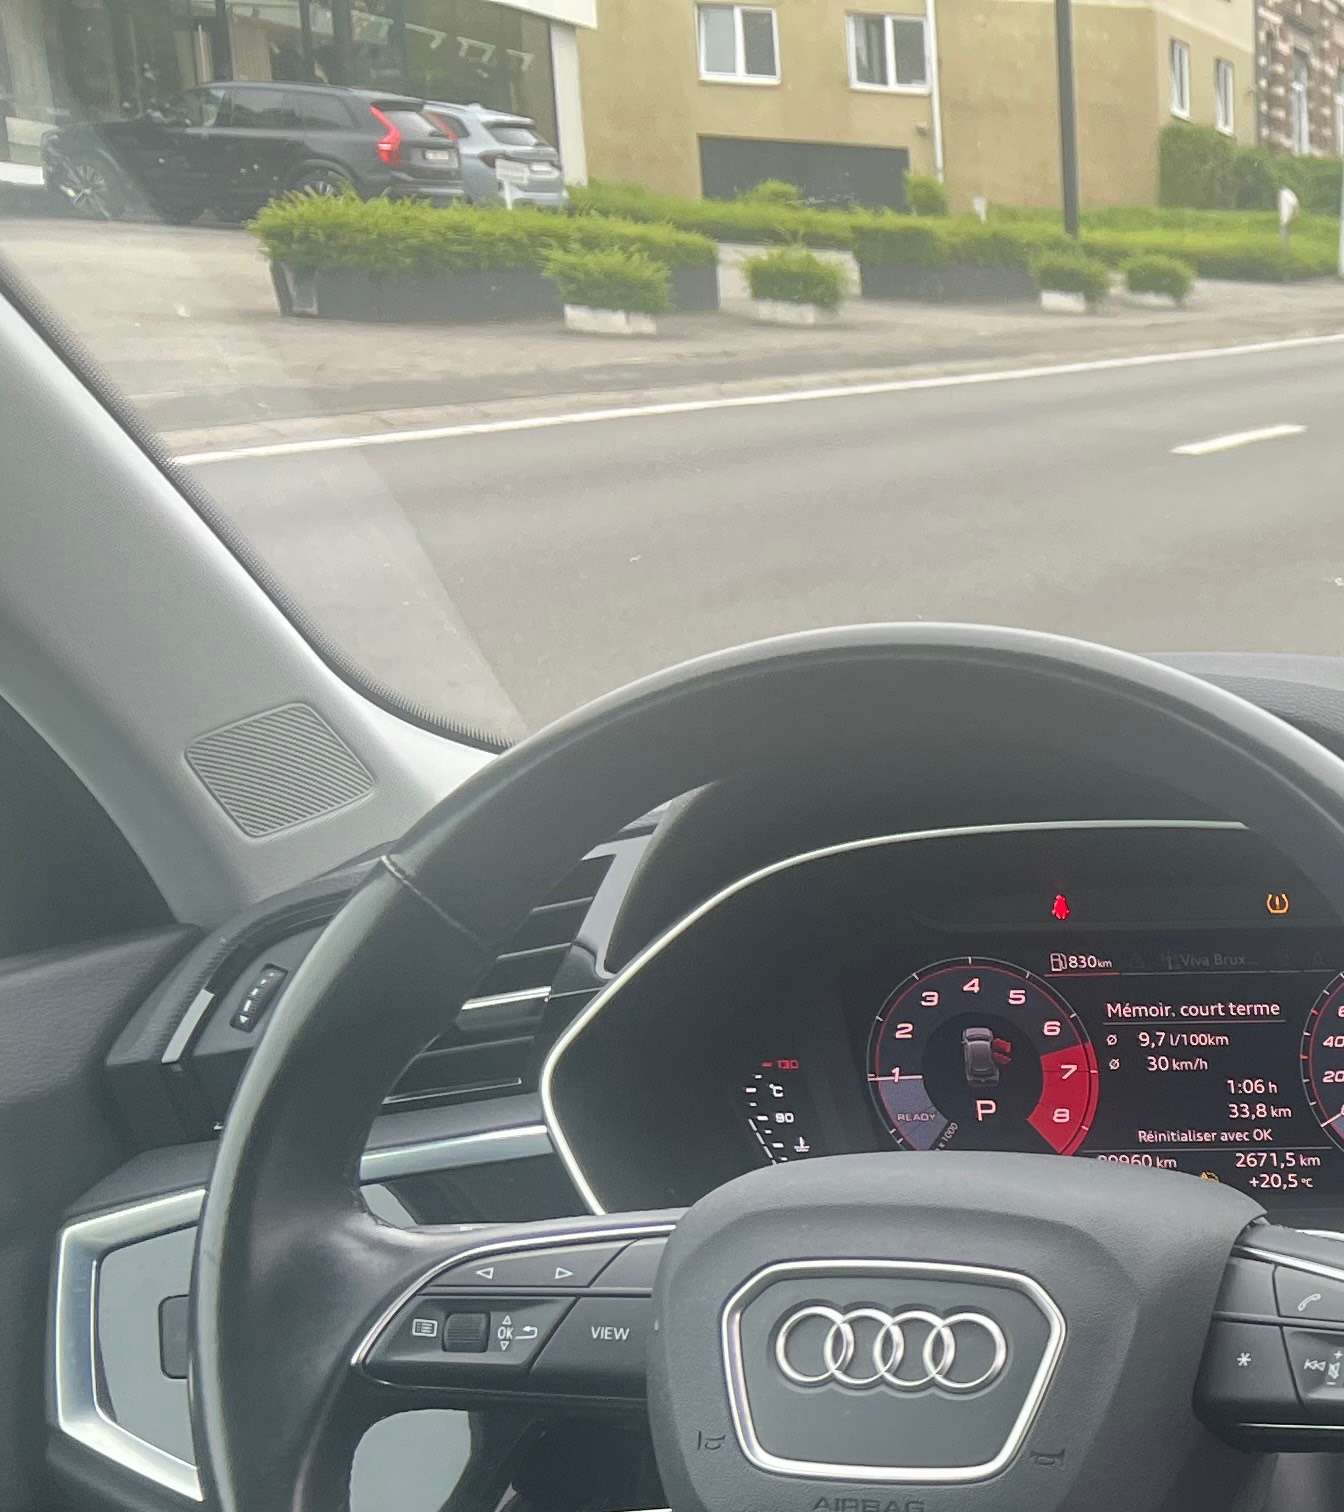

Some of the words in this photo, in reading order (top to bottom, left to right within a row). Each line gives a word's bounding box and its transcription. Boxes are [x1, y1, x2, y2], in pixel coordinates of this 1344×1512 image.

[963, 978, 981, 993] 4
[920, 992, 939, 1007] 3
[1008, 990, 1026, 1004] 5
[1107, 1002, 1176, 1018] Mémoir.
[1180, 1003, 1226, 1017] court
[1229, 1002, 1280, 1016] terme
[895, 1023, 914, 1039] 2
[1043, 1021, 1061, 1036] 6
[1139, 1031, 1166, 1049] 9,7
[1170, 1032, 1229, 1047] l/100km
[1147, 1056, 1169, 1071] 30
[1173, 1058, 1208, 1072] km/h
[892, 1067, 900, 1083] 1
[1060, 1066, 1078, 1079] 7
[1227, 1079, 1265, 1094] 1:06
[1269, 1080, 1278, 1094] h
[775, 1112, 795, 1123] 90
[976, 1100, 997, 1120] P
[1052, 1109, 1070, 1123] 8
[1228, 1103, 1267, 1120] 33,8
[1271, 1105, 1292, 1118] km
[1138, 1130, 1217, 1143] Réinitialiser
[1221, 1131, 1250, 1142] avec
[1253, 1129, 1273, 1142] OK
[1157, 1155, 1177, 1169] km
[1236, 1152, 1296, 1169] 2671,5
[1300, 1153, 1321, 1167] km
[1250, 1174, 1298, 1190] +20,5
[497, 1325, 514, 1341] OK
[590, 1326, 630, 1342] VIEW
